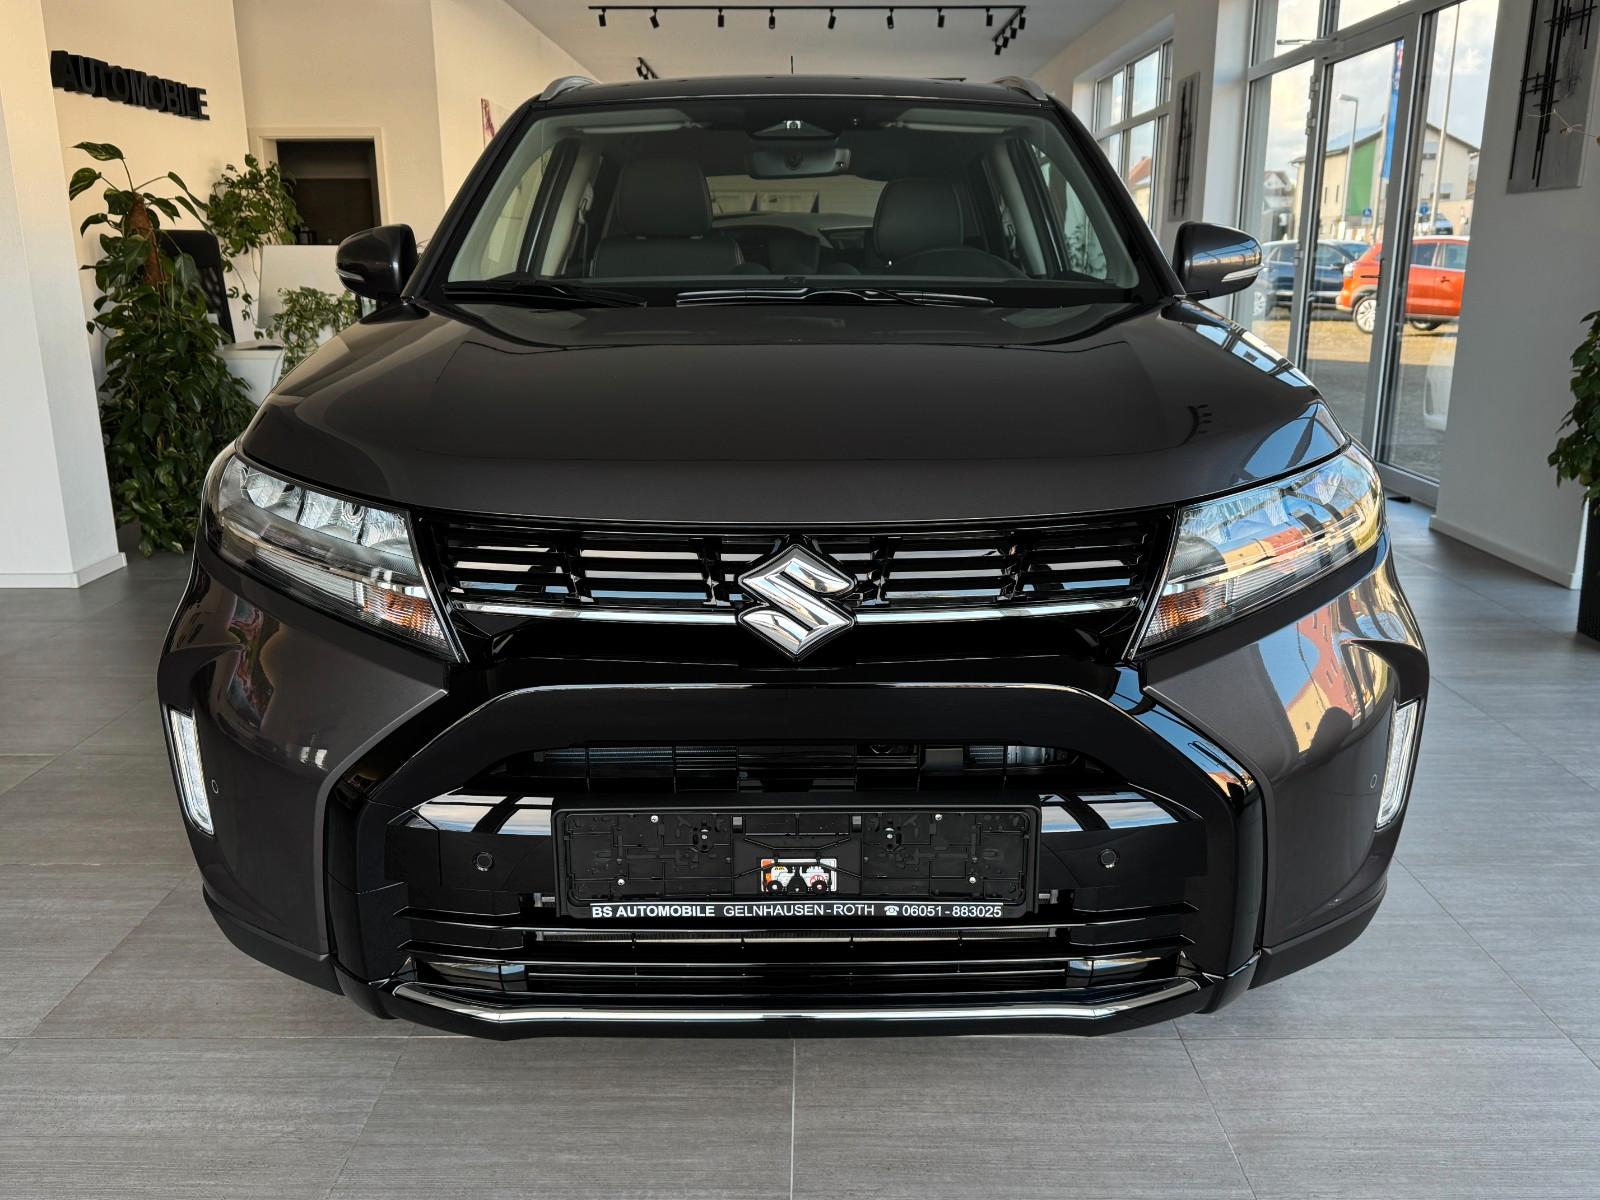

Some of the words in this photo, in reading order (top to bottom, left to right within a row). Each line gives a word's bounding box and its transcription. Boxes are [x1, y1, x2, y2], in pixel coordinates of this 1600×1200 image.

[51, 50, 210, 121] AUTOMOBILE
[591, 905, 613, 918] BS
[616, 905, 715, 918] AUTOMOBILE
[902, 905, 1002, 918] 06051-883025
